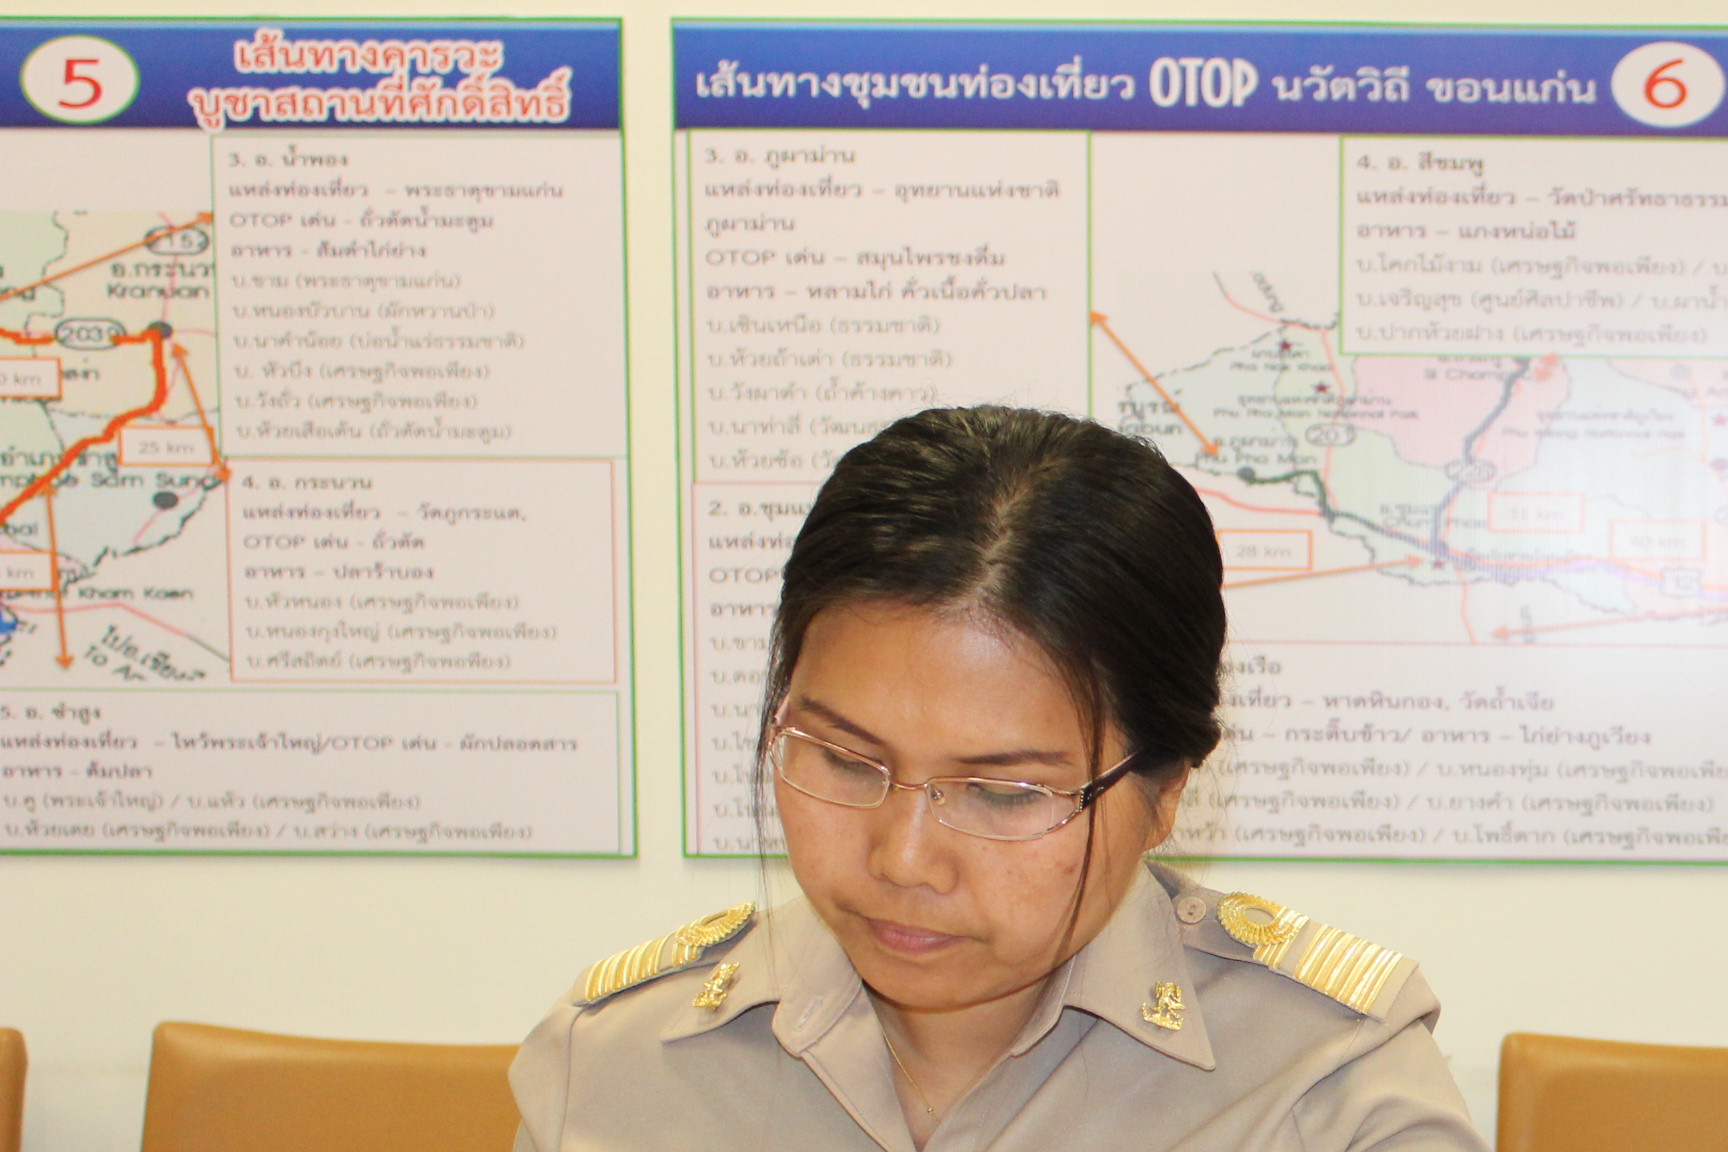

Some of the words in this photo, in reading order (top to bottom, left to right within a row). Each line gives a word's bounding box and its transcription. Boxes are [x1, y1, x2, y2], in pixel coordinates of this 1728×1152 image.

[235, 31, 502, 72] เส้นทางคารวะ
[58, 58, 102, 109] 5
[696, 57, 1136, 110] เส้นทางชุมชนท่องเที่ยว
[1149, 57, 1259, 107] OTOP
[1271, 65, 1410, 104] นวัตวิถี
[1427, 69, 1597, 105] ขอนแก่น
[1644, 59, 1687, 110] 6
[191, 66, 571, 128] บูชาสถานที่ศักดิ์สิทธิ์
[228, 151, 246, 168] 3.
[254, 153, 272, 168] อ.
[281, 143, 349, 168] น้ำพอง
[705, 147, 724, 164] 3.
[734, 149, 754, 164] อ.
[764, 144, 857, 171] ภูผาม่าน
[1356, 154, 1376, 170] 4.
[1387, 156, 1408, 172] อ.
[228, 176, 370, 198] แหล่งท่องเที่ยว
[404, 181, 564, 204] พระธาตุขามแก่น
[704, 174, 864, 198] แหล่งท่องเที่ยว
[894, 178, 1061, 204] อุทยานแห่งชาติ
[1356, 181, 1517, 206] แหล่งท่องเที่ยว
[228, 211, 294, 229] OTOP
[300, 211, 337, 228] เด่น
[704, 212, 796, 239] ภูผาม่าน
[1356, 224, 1428, 239] อาหาร
[230, 244, 293, 258] อาหาร
[704, 248, 777, 267] OTOP
[785, 247, 826, 266] เด่น
[1490, 254, 1686, 281] (เศรษฐกิจพอเพียง)
[706, 285, 776, 300] อาหาร
[1512, 322, 1708, 349] (เศรษฐกิจพอเพียง)
[318, 359, 491, 385] (เศรษฐกิจพอเพียง)
[307, 390, 479, 418] (เศรษฐกิจพอเพียง)
[138, 440, 161, 456] 25
[165, 441, 195, 455] km
[241, 474, 255, 490] 4.
[268, 476, 285, 491] อ.
[294, 476, 374, 491] กระนวน
[242, 498, 382, 520] แหล่งท่องเที่ยว
[708, 500, 729, 517] 2.
[242, 533, 307, 550] OTOP
[313, 533, 350, 550] เด่น
[1235, 544, 1259, 559] 28
[1263, 545, 1292, 559] km
[244, 566, 306, 580] อาหาร
[349, 591, 520, 616] (เศรษฐกิจพอเพียง)
[387, 620, 558, 646] (เศรษฐกิจพอเพียง)
[348, 650, 512, 675] (เศรษฐกิจพอเพียง)
[0, 704, 16, 720] 5.
[24, 706, 43, 720] อ.
[0, 728, 139, 750] แหล่งท่องเที่ยว
[401, 734, 438, 751] เด่น
[1420, 731, 1490, 744] อาหาร
[1, 765, 63, 779] อาหาร
[251, 791, 421, 815] (เศรษฐกิจพอเพียง)
[1522, 793, 1714, 817] (เศรษฐกิจพอเพียง)
[101, 819, 271, 844] (เศรษฐกิจพอเพียง)
[364, 820, 533, 845] (เศรษฐกิจพอเพียง)
[1235, 823, 1426, 848] (เศรษฐกิจพอเพียง)
